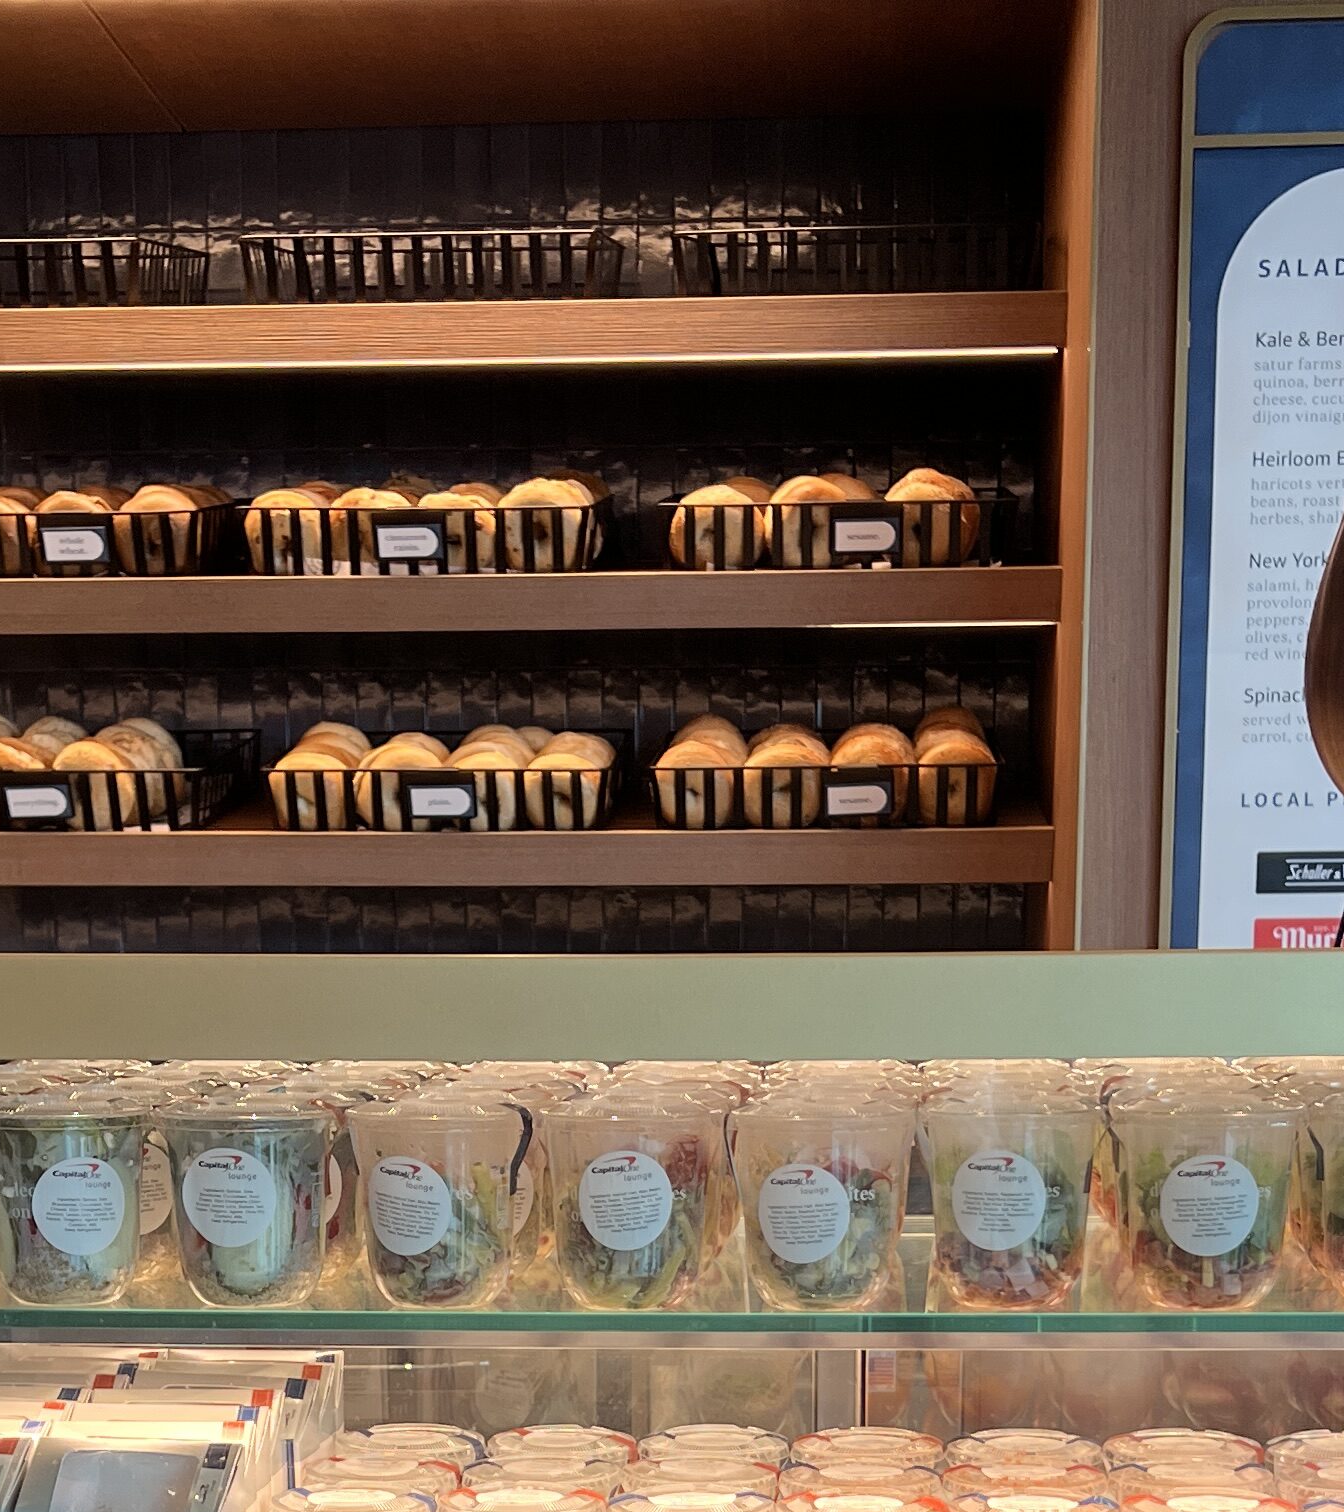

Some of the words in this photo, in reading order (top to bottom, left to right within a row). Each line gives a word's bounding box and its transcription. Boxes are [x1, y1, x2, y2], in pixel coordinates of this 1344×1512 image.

[1256, 331, 1292, 347] Kale
[1298, 332, 1310, 347] &
[1298, 357, 1341, 371] farms
[1254, 376, 1308, 391] quinoa,
[1253, 393, 1307, 406] cheese,
[1253, 410, 1290, 425] dijon
[1253, 450, 1331, 467] Heirloom
[1251, 478, 1311, 491] haricots
[1250, 496, 1298, 508] beans,
[1250, 513, 1304, 525] herbes,
[1249, 553, 1287, 569] New
[1293, 552, 1329, 567] York
[1248, 579, 1301, 593] salami,
[1247, 597, 1315, 611] provolon
[1245, 631, 1292, 644] olives,
[1245, 649, 1269, 661] red
[1242, 713, 1291, 725] served
[1242, 731, 1292, 744] carrot,
[1241, 793, 1314, 808] LOCAL
